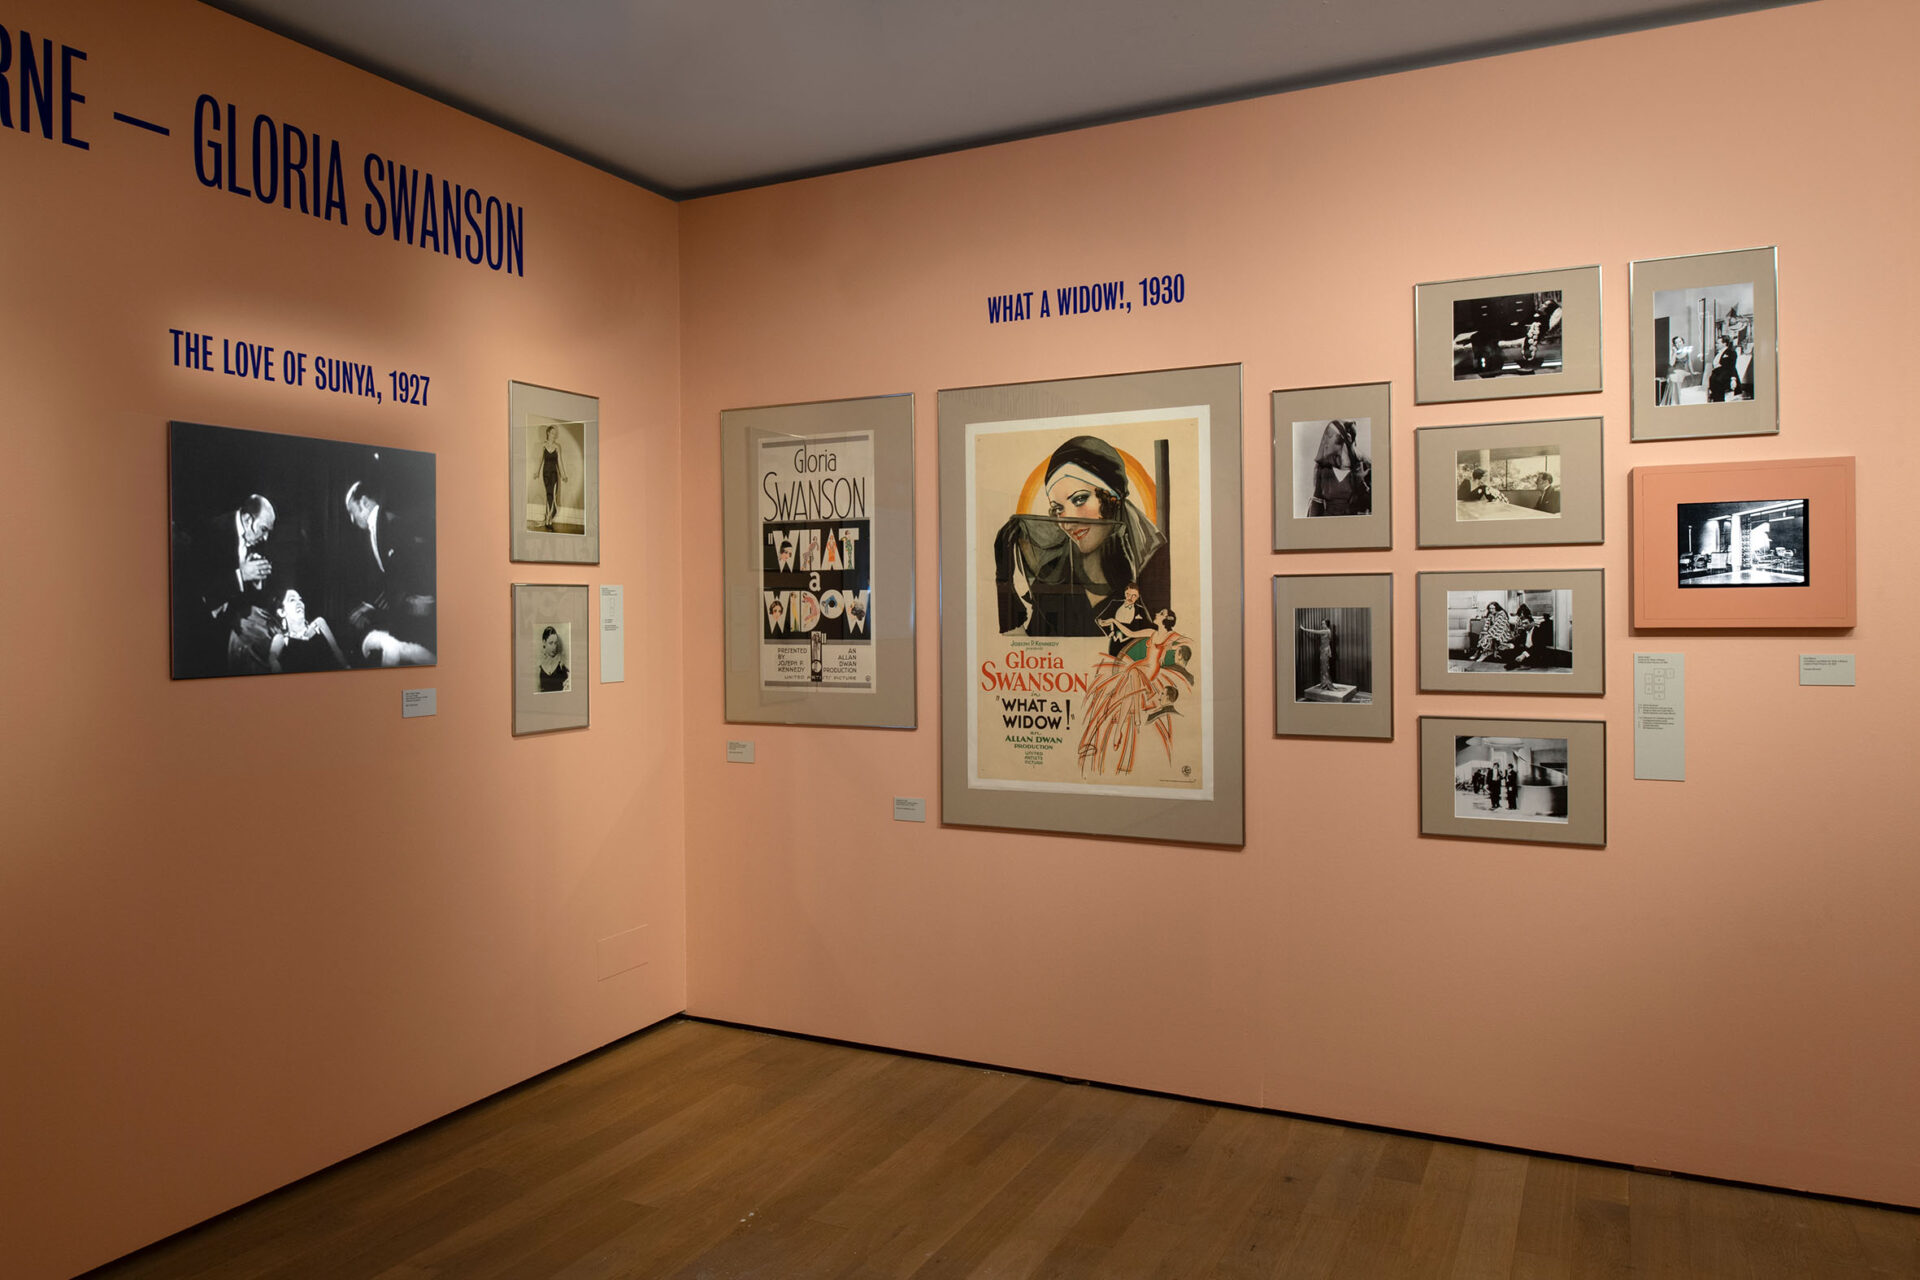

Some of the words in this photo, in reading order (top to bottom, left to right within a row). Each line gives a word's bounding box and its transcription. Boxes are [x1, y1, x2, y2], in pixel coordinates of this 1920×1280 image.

[194, 94, 348, 226] GLORIA
[364, 153, 524, 277] SWANSON
[987, 291, 1034, 324] WHAT
[1040, 290, 1051, 318] A
[1057, 281, 1132, 316] WIDOW!,
[1139, 273, 1185, 307] 1930
[169, 328, 214, 372] THE
[223, 339, 275, 382] LOVE
[283, 350, 307, 386] OF
[314, 355, 382, 404] SUNYA,
[389, 370, 430, 407] 1927
[794, 440, 837, 474] Gloria
[763, 471, 865, 522] SWANSON
[809, 571, 821, 592] a
[1005, 650, 1064, 670] Gloria
[981, 661, 1088, 693] SWANSON
[1050, 701, 1063, 713] a
[1005, 735, 1033, 743] ALLAN
[1035, 736, 1063, 744] DWAN
